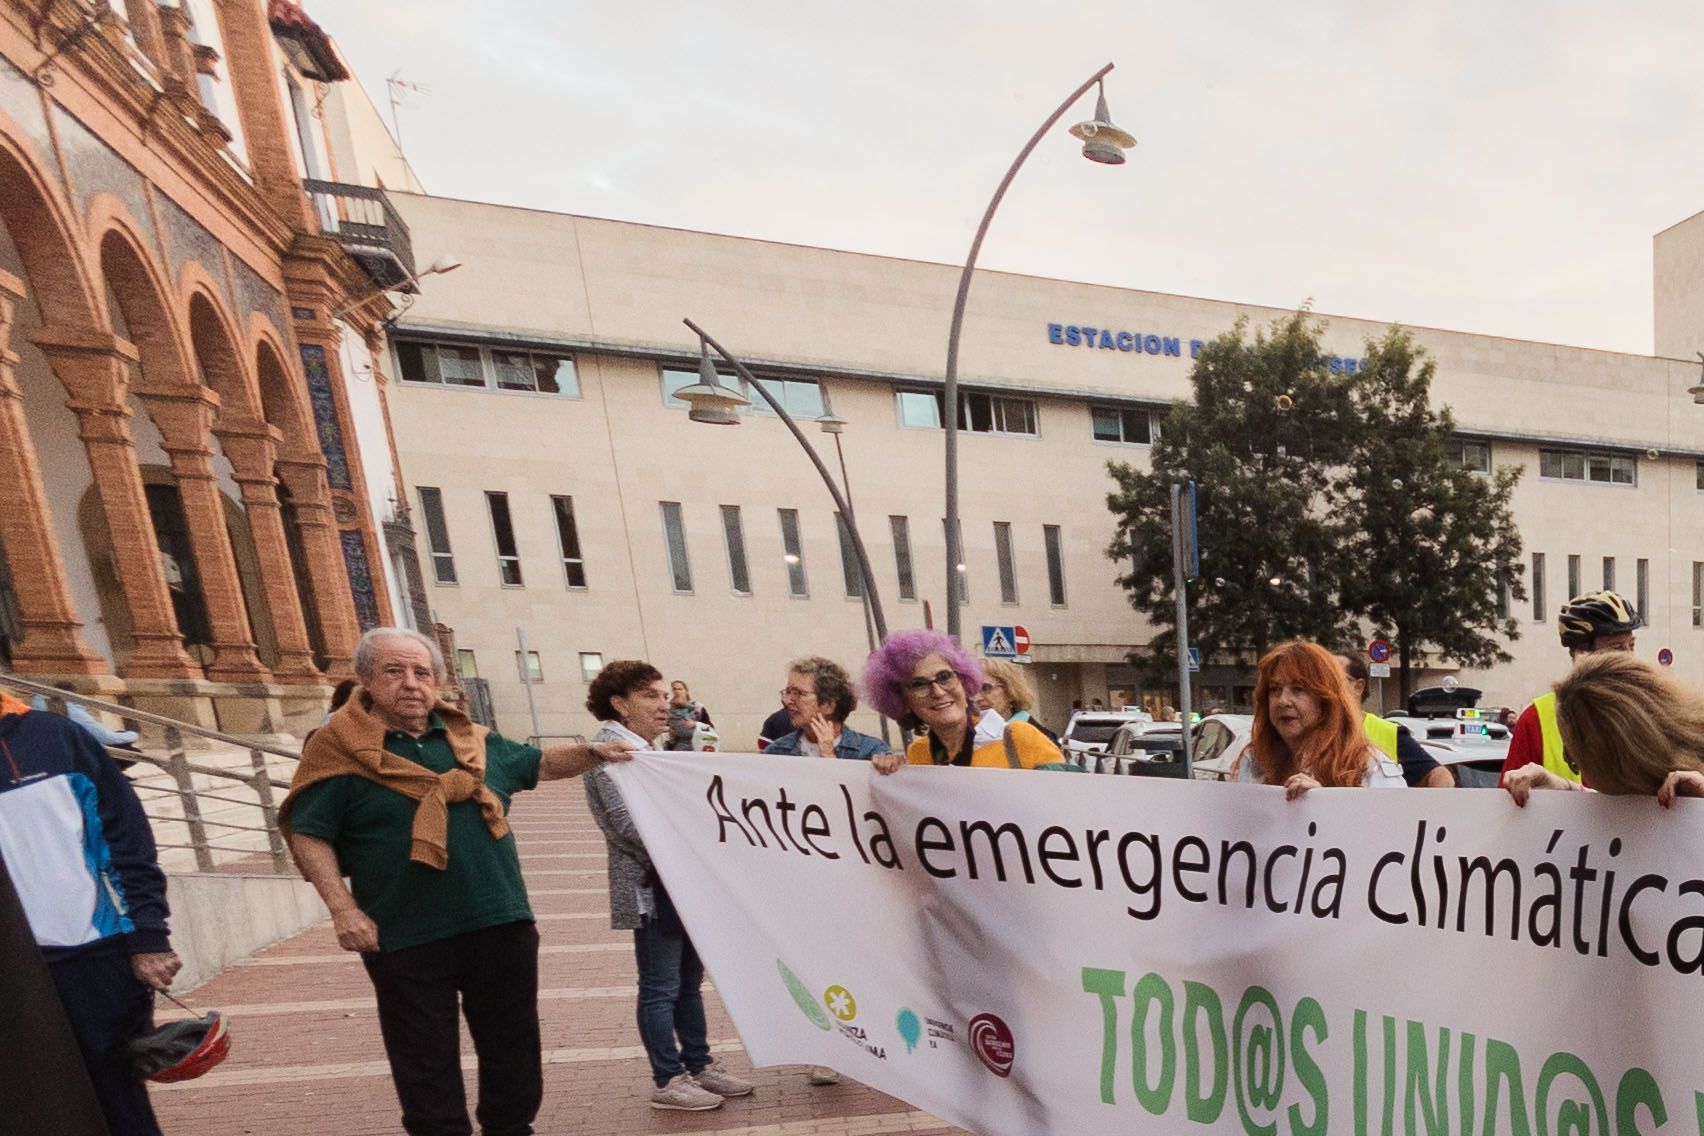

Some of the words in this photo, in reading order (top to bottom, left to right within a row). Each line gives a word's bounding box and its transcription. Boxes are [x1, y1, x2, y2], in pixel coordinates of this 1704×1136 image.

[1047, 323, 1182, 357] ESTACION
[706, 774, 841, 860] Ante
[839, 783, 905, 872] la
[912, 815, 1347, 921] emergencia
